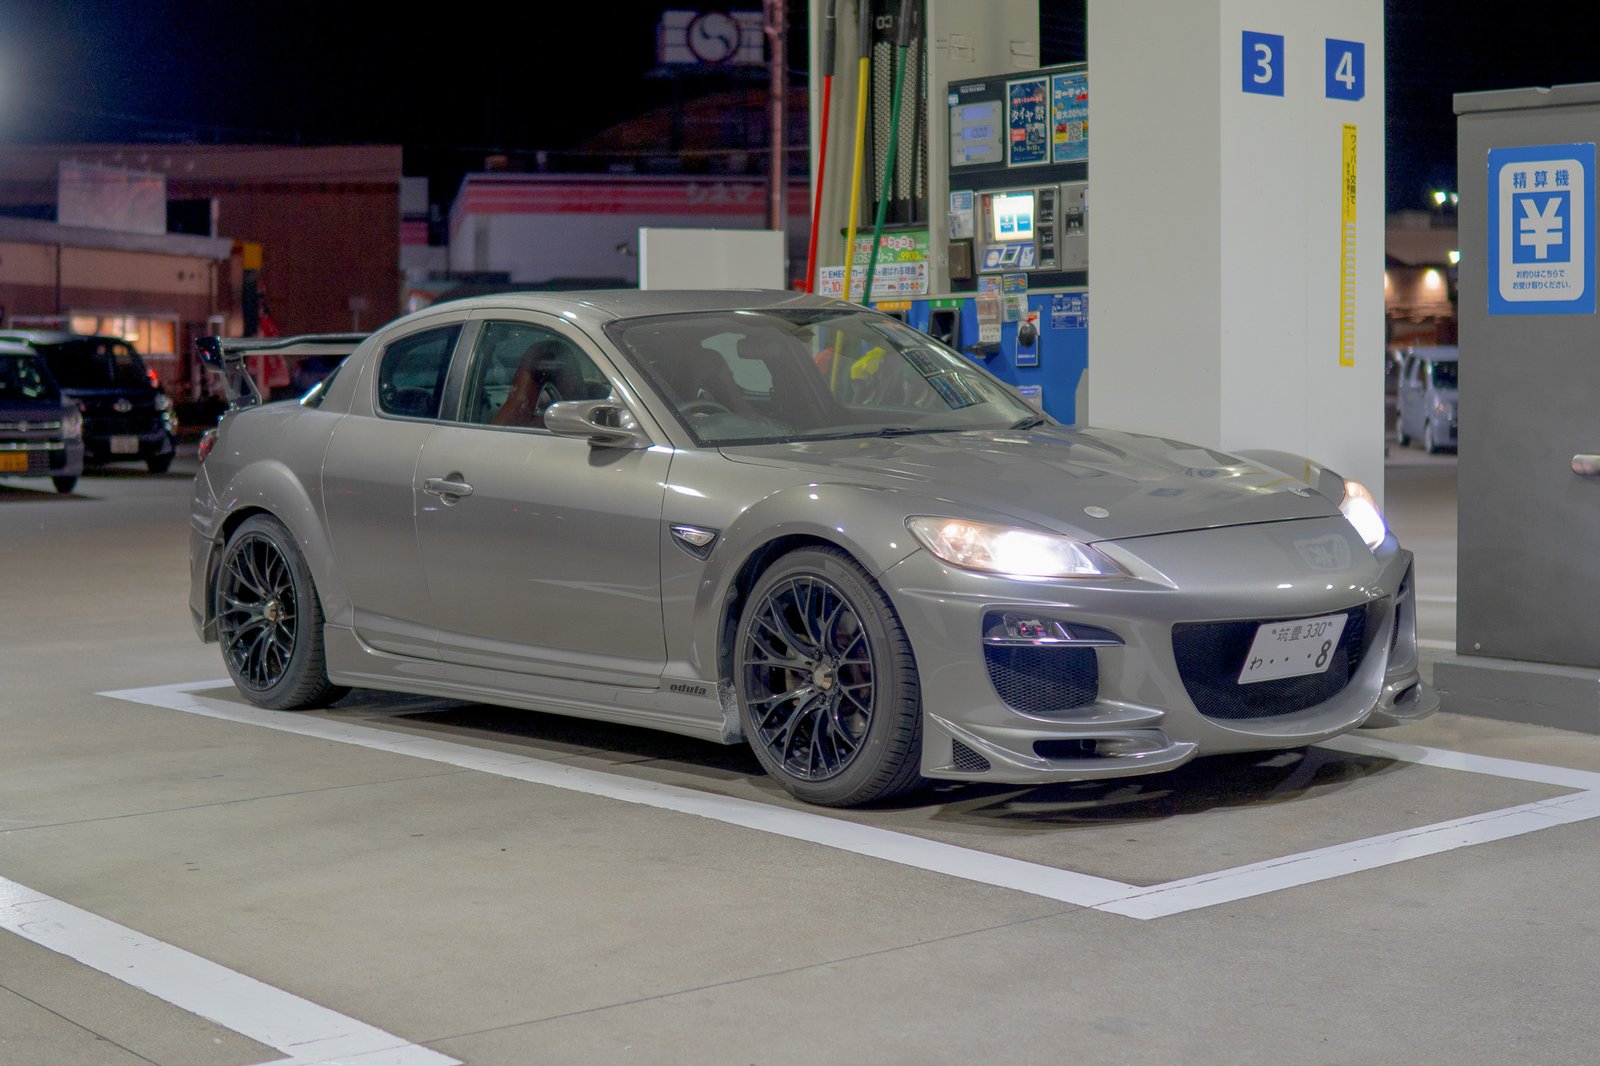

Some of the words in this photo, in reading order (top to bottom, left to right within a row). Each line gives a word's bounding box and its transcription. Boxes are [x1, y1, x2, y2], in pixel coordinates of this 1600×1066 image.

[1253, 43, 1273, 84] 3
[1335, 51, 1356, 90] 4
[1512, 170, 1569, 189] 精算機
[1516, 269, 1565, 278] お釣りはこちらで
[1277, 625, 1303, 642] 筑豊
[1303, 621, 1327, 639] 330
[1249, 656, 1263, 671] わ
[1314, 639, 1332, 668] 8
